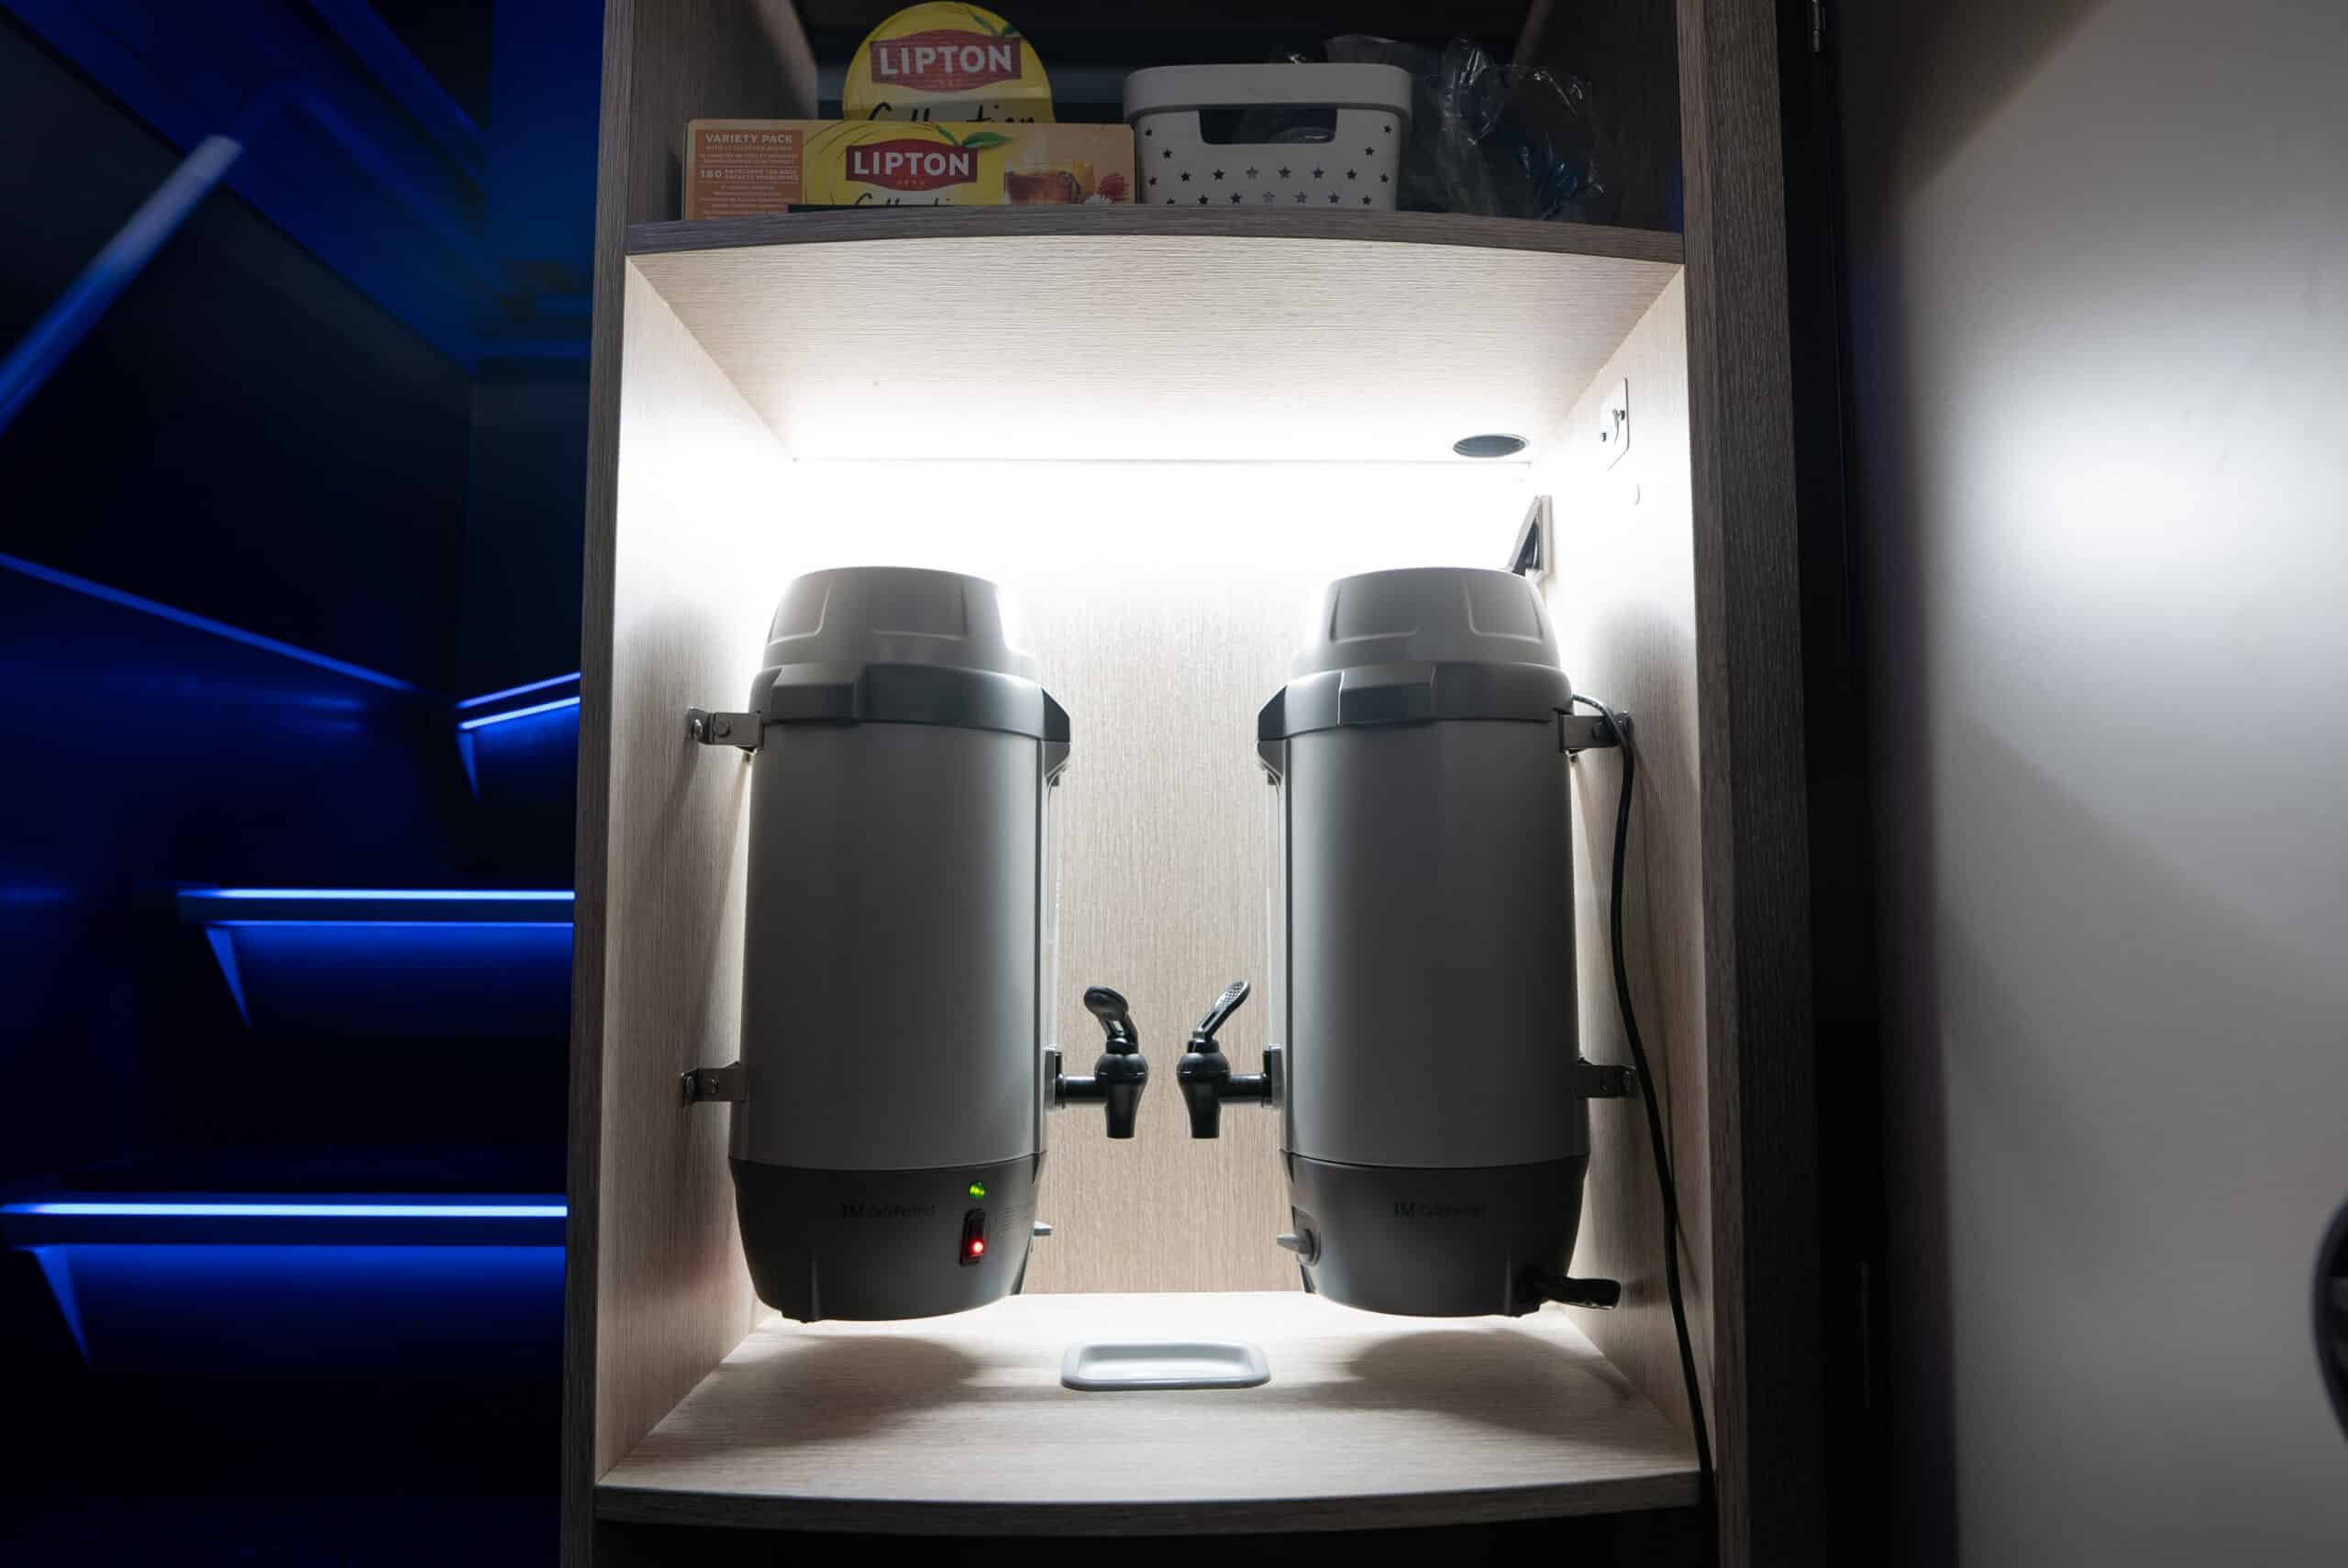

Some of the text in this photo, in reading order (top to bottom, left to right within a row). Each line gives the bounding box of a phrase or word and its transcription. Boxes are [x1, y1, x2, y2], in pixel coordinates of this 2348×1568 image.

[880, 44, 1013, 75] LIPTON
[705, 134, 793, 143] VARIETY PACK
[853, 151, 969, 176] LIPTON
[700, 169, 723, 179] 180
